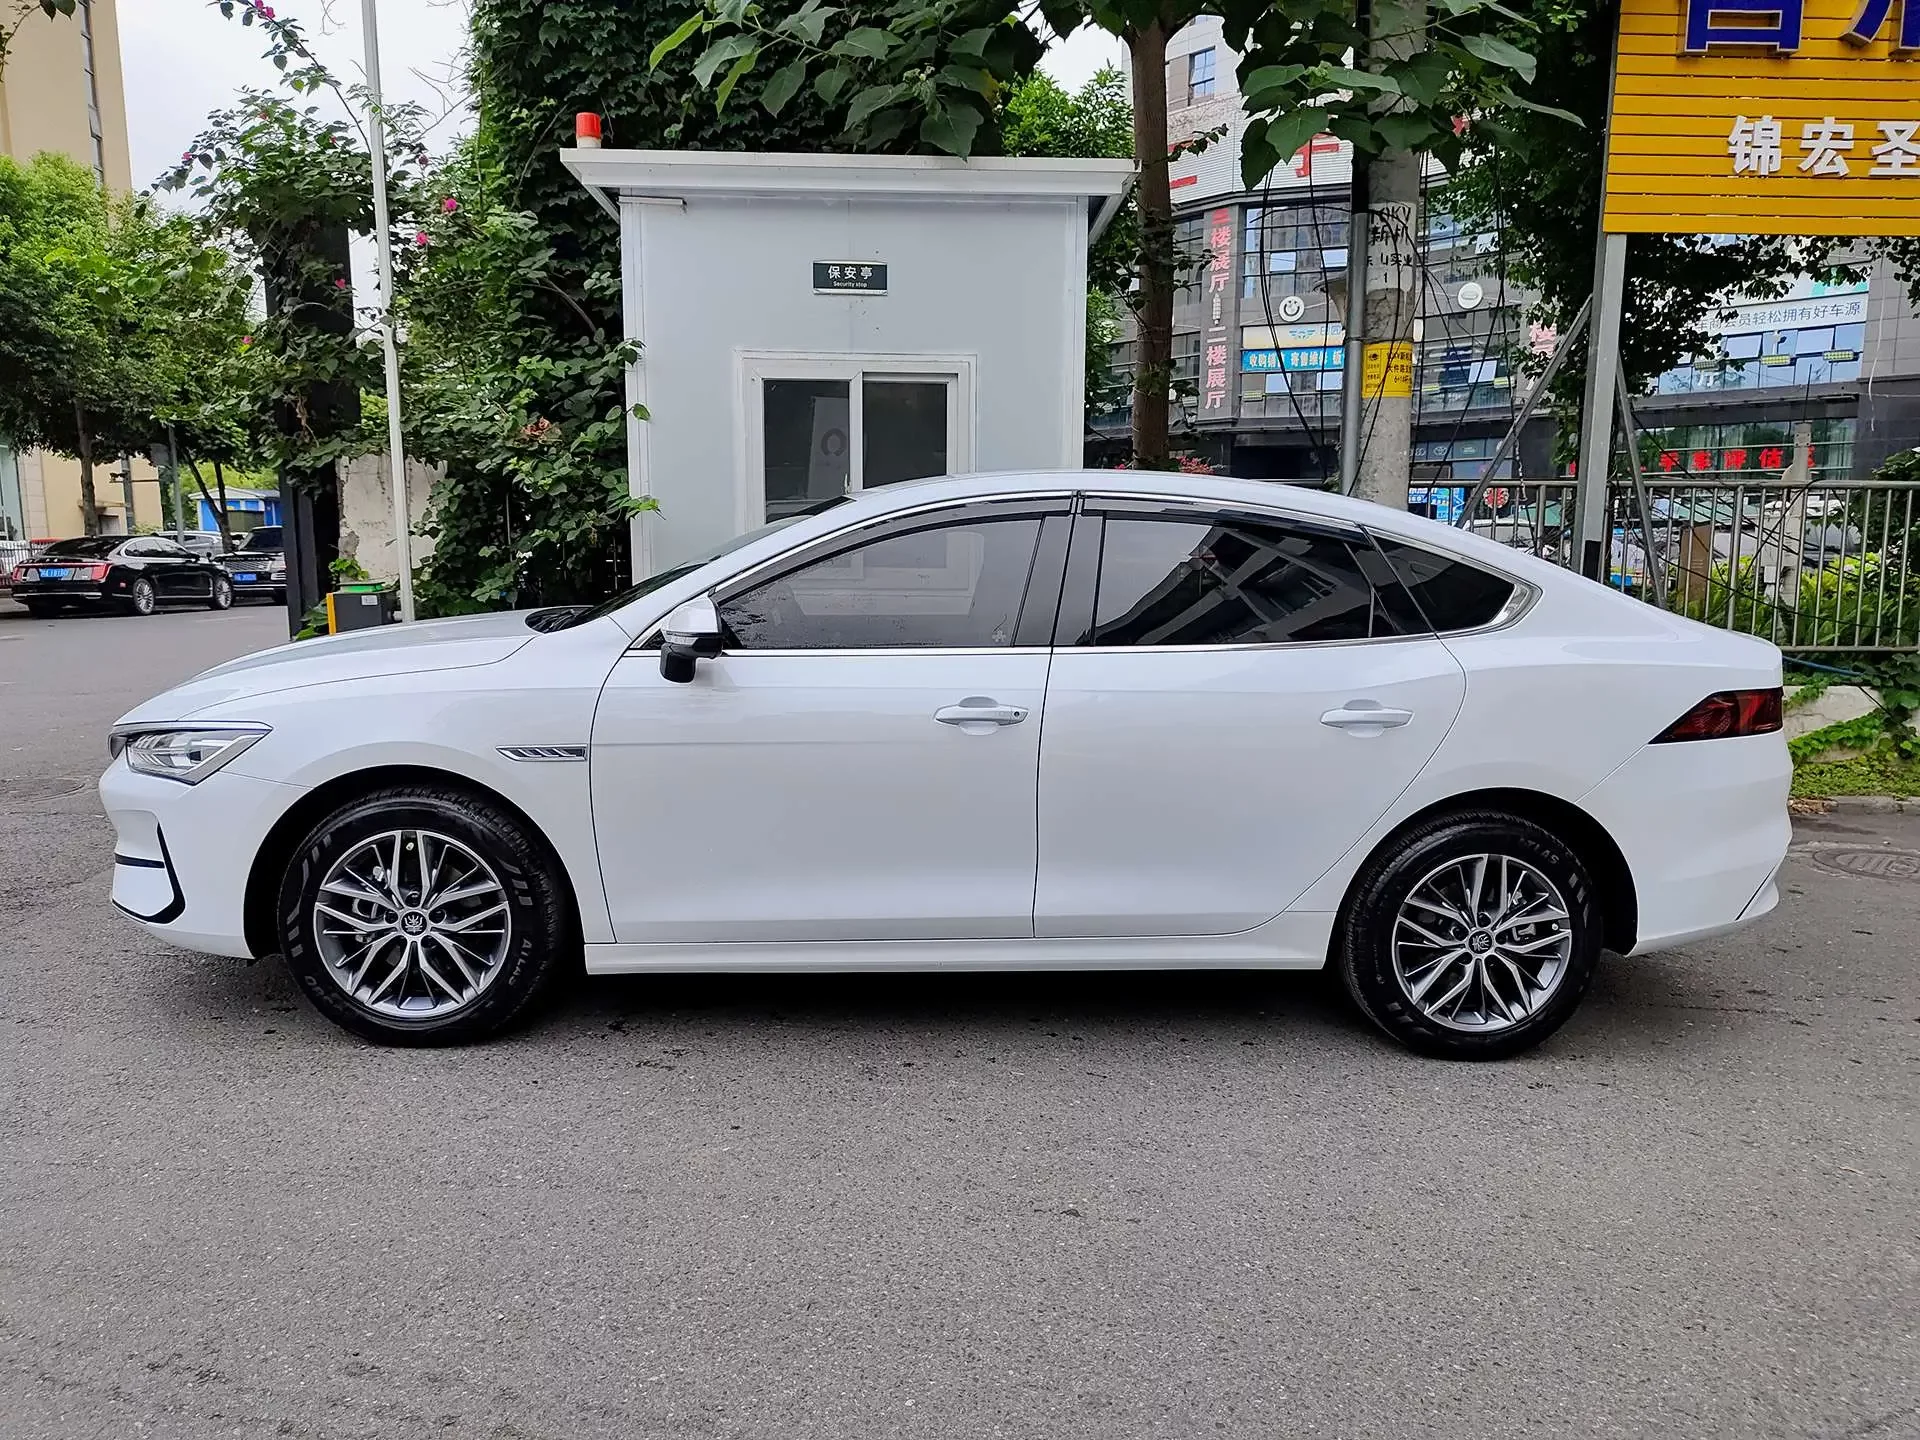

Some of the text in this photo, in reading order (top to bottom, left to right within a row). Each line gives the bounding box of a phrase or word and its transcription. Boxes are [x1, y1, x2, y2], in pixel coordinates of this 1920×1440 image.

[1727, 115, 1920, 177] 锦宏圣
[828, 265, 873, 280] 保安亭
[1209, 208, 1232, 293] 三楼展厅
[1205, 325, 1227, 410] 二楼展厅
[1627, 447, 1816, 472] 手车评估
